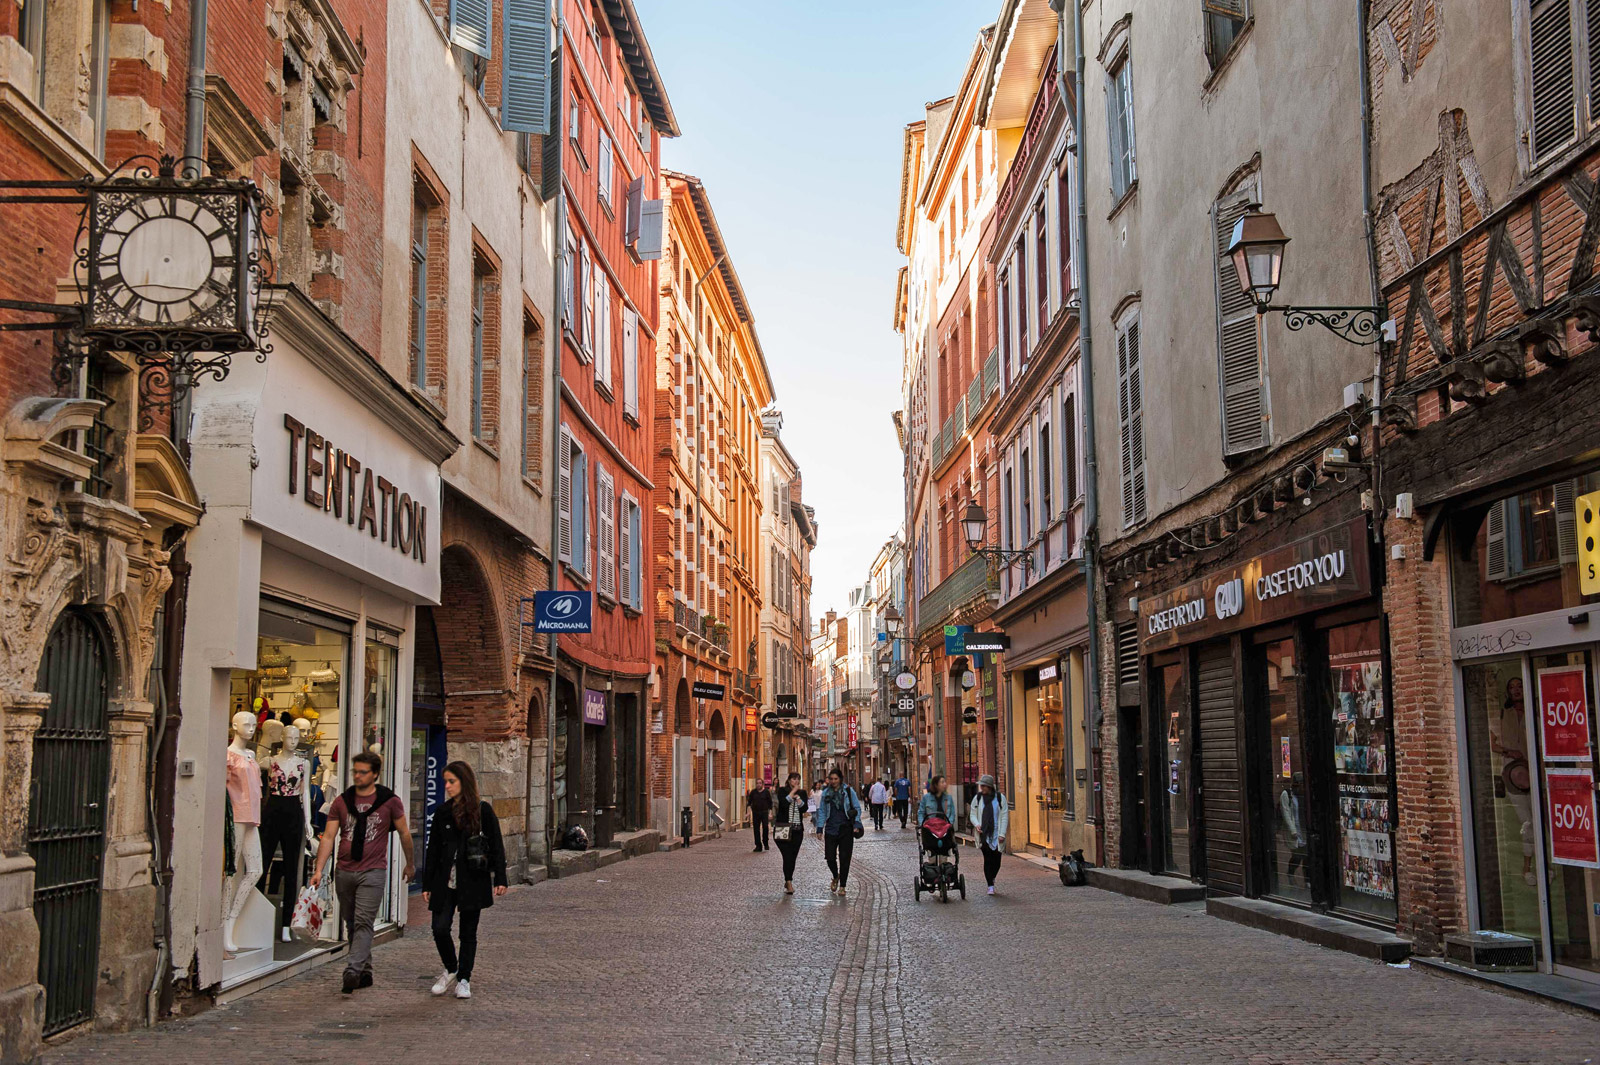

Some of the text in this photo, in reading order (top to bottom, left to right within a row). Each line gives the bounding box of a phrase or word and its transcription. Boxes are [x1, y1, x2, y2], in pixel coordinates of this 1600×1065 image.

[284, 413, 427, 564] TENTATION
[1256, 550, 1345, 601] CASE FOR YOU
[1149, 598, 1205, 634] CASE FOR YOU
[1215, 578, 1244, 620] C4U
[538, 619, 588, 629] MICROMANIA
[1547, 701, 1585, 727] 50%
[427, 756, 437, 806] VIDEO
[1555, 804, 1590, 830] 50%
